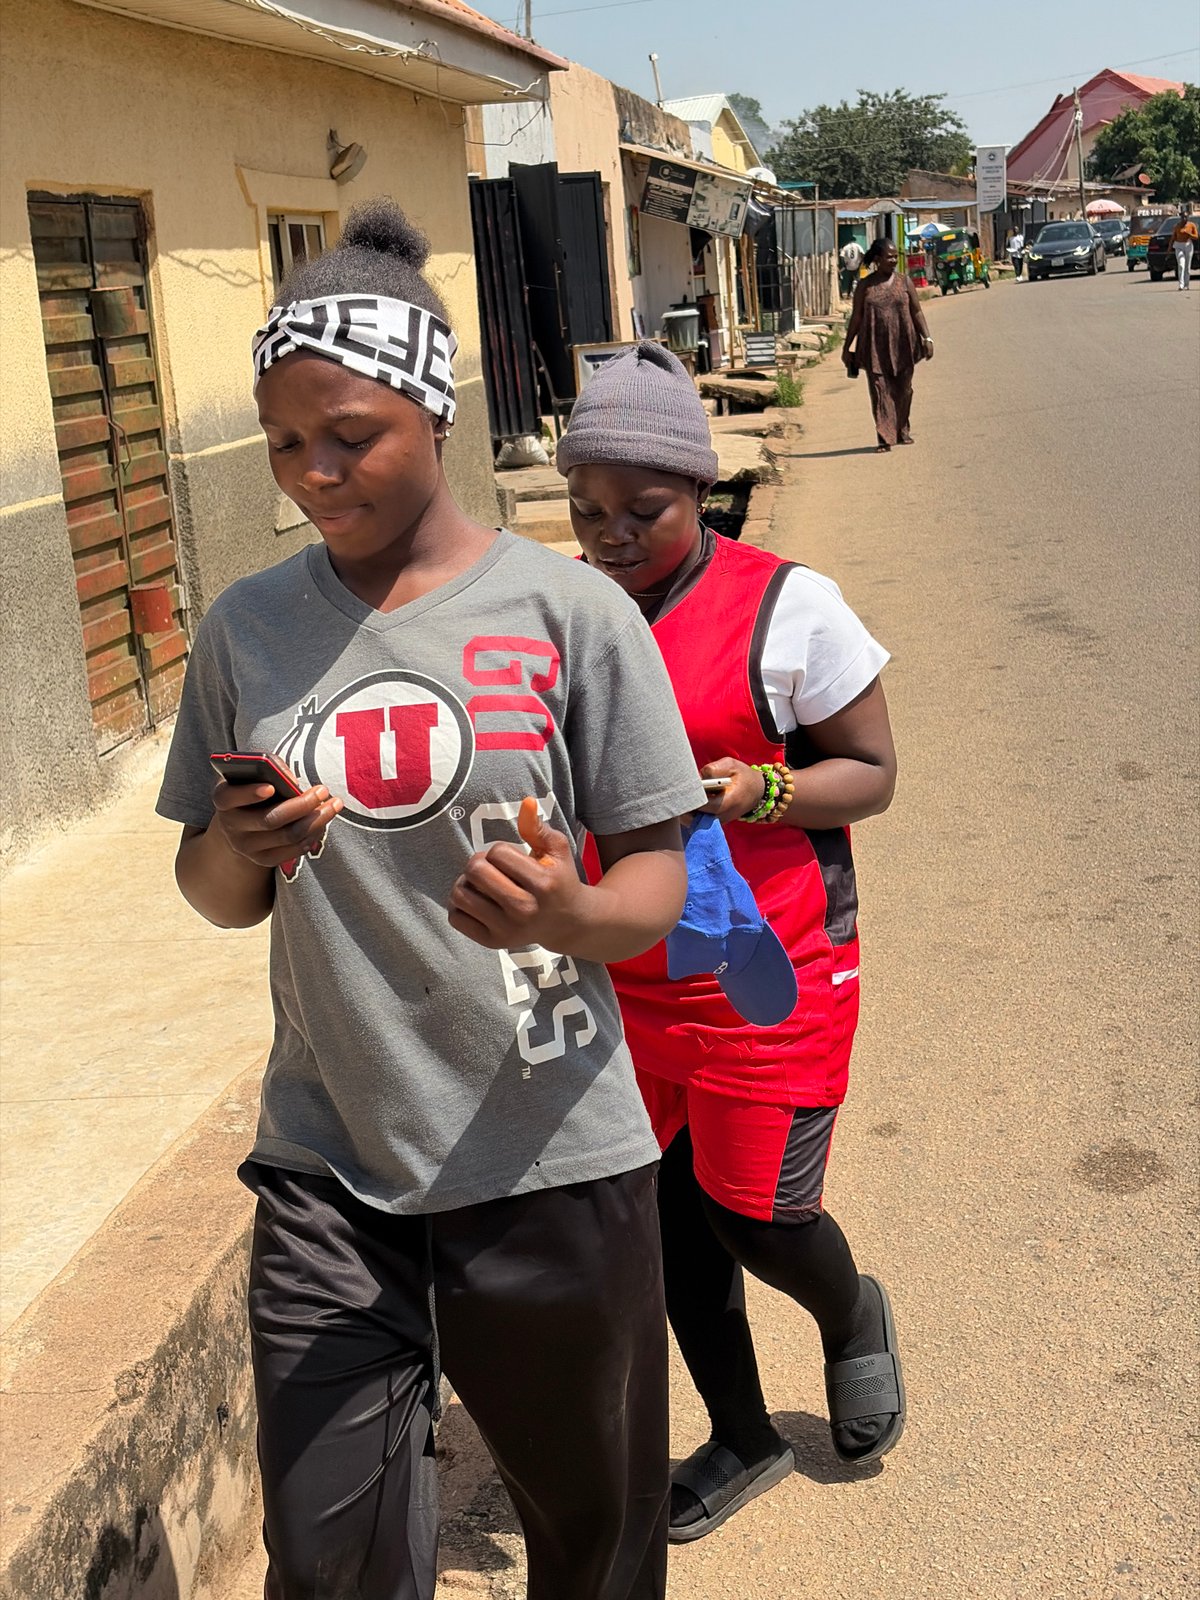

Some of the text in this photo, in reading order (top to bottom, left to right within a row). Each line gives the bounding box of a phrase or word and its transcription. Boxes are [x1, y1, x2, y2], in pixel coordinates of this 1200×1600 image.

[462, 635, 561, 752] GO
[336, 702, 439, 810] U
[470, 790, 598, 1066] UES
